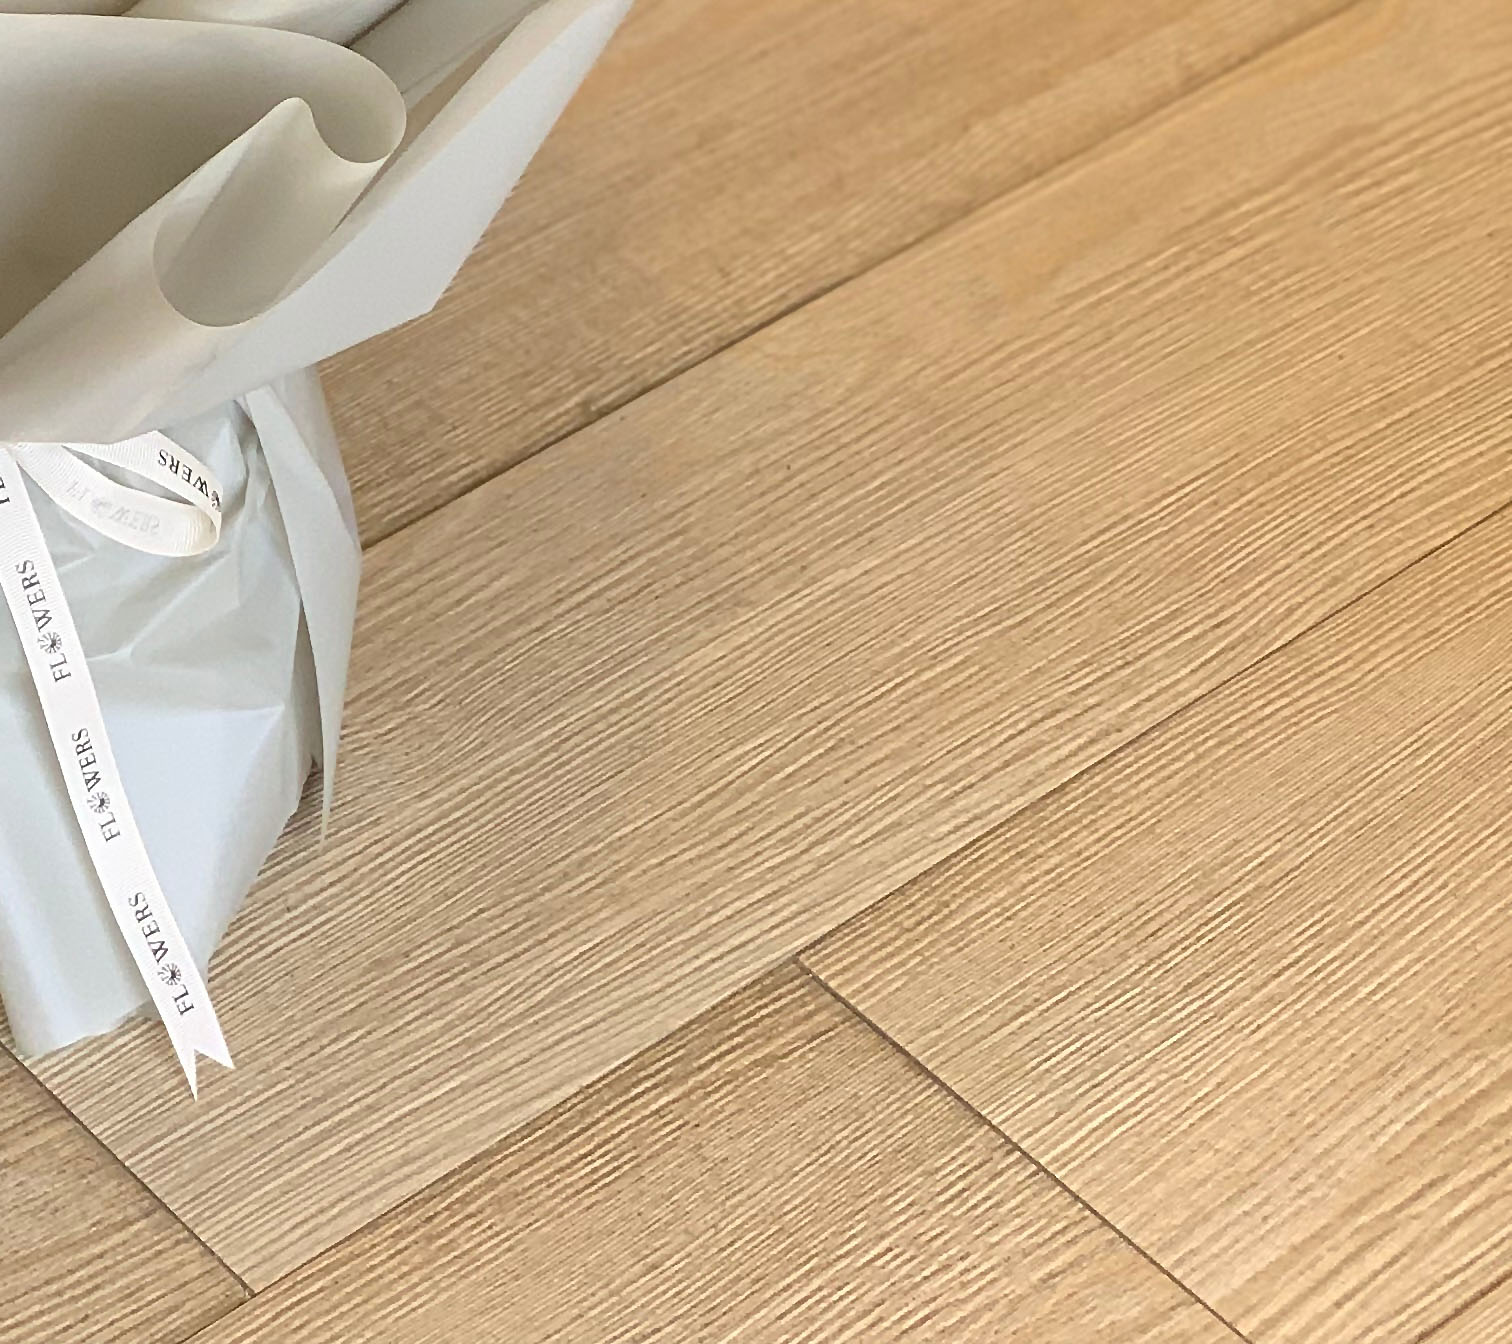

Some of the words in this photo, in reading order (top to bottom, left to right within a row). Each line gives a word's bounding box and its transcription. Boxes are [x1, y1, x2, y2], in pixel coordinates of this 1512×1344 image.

[15, 559, 72, 683] FLOWERS
[71, 727, 121, 842] FLOWERS
[128, 892, 195, 1016] FLOWERS
